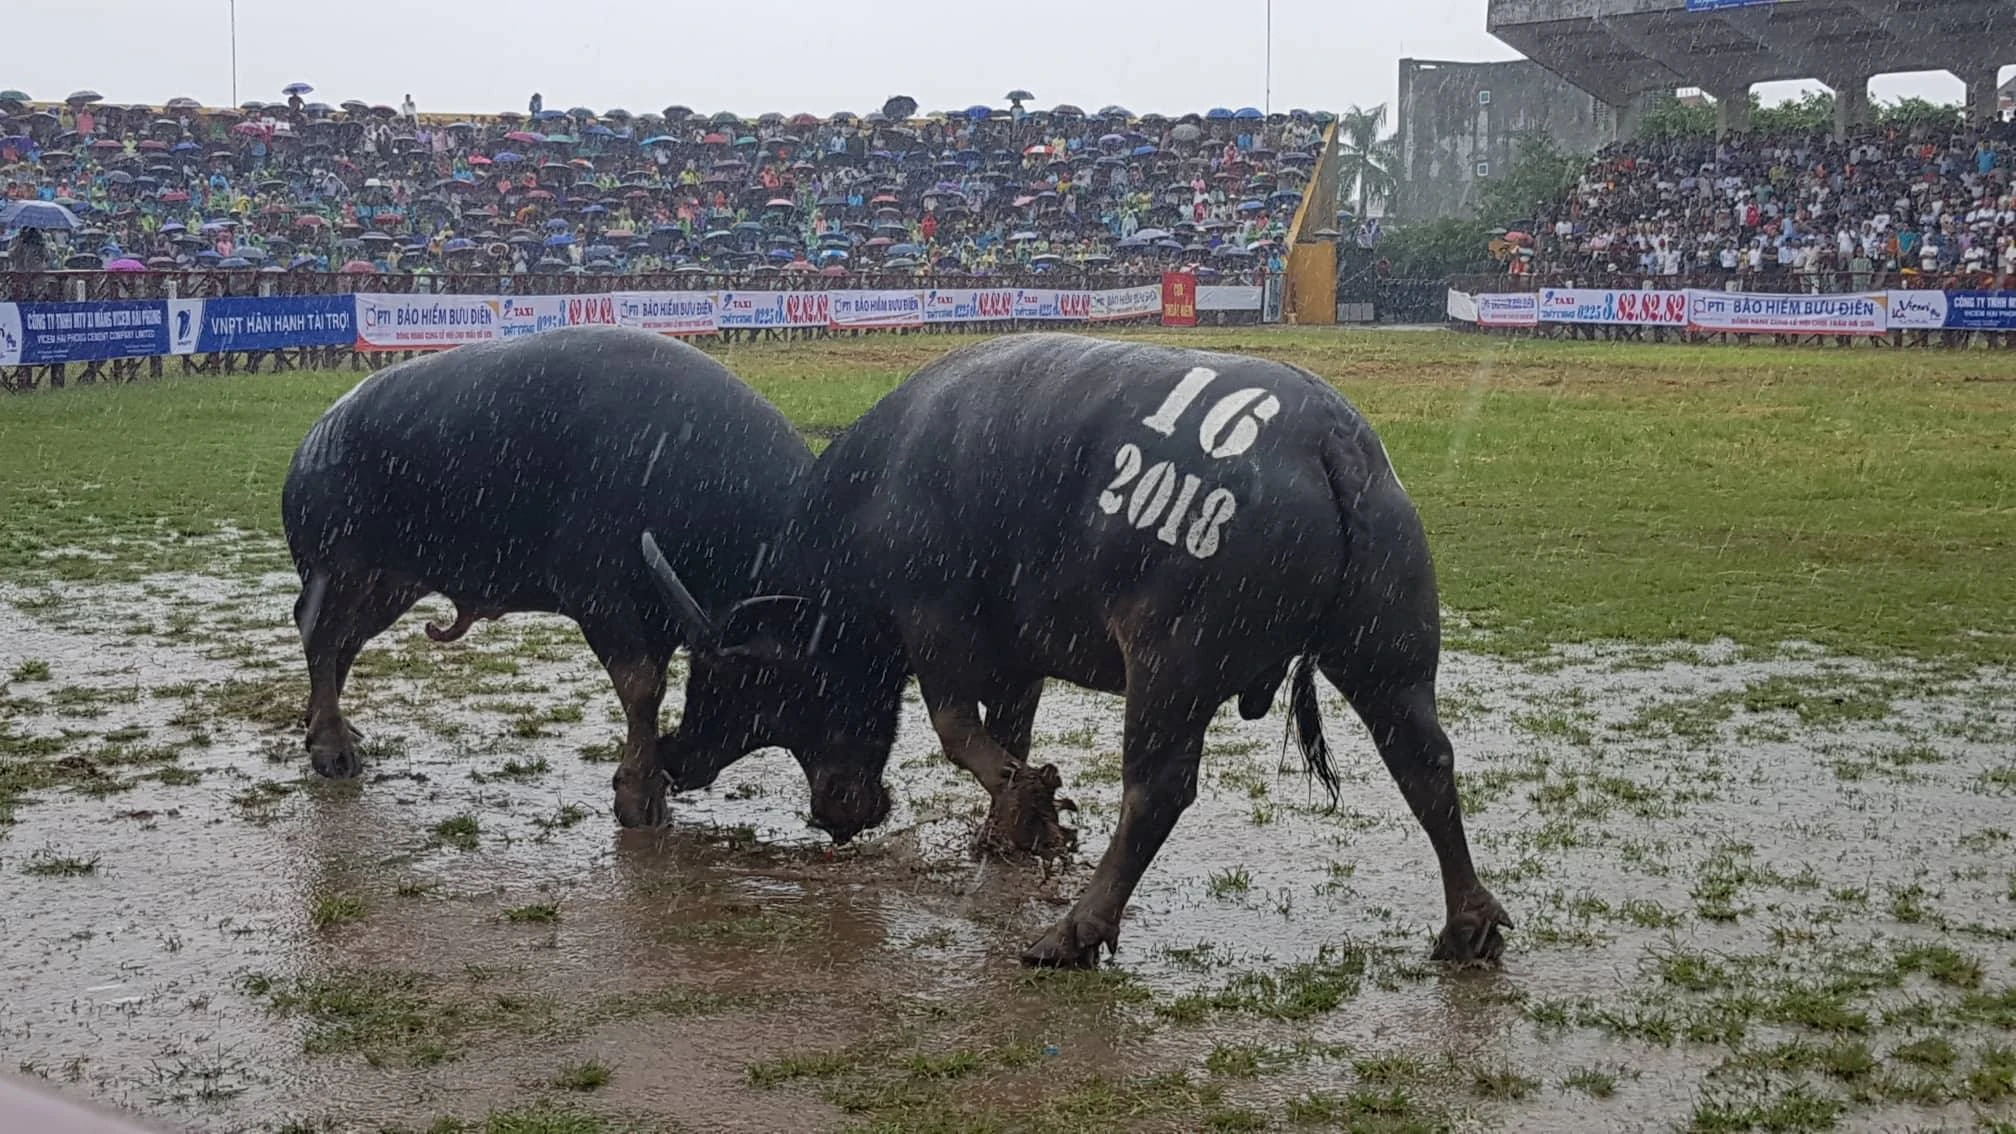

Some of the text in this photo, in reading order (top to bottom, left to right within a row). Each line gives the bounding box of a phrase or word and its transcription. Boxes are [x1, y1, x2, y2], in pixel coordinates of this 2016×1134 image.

[733, 301, 752, 309] TAXI
[1555, 297, 1575, 305] TAXI
[1707, 301, 1725, 313] PTI
[1733, 297, 1762, 314] BẢO
[1804, 299, 1835, 315] BƯU
[377, 310, 391, 325] PTI
[397, 304, 419, 326] BẢO
[421, 303, 447, 325] HIỂM
[449, 306, 469, 325] BƯU
[514, 307, 534, 317] TAXI
[1577, 304, 1601, 320] 0225
[211, 316, 244, 335] VNPT
[274, 313, 305, 336] HẠNH
[307, 310, 324, 330] TÀI
[1142, 367, 1281, 459] 16
[1099, 443, 1236, 559] 2018
